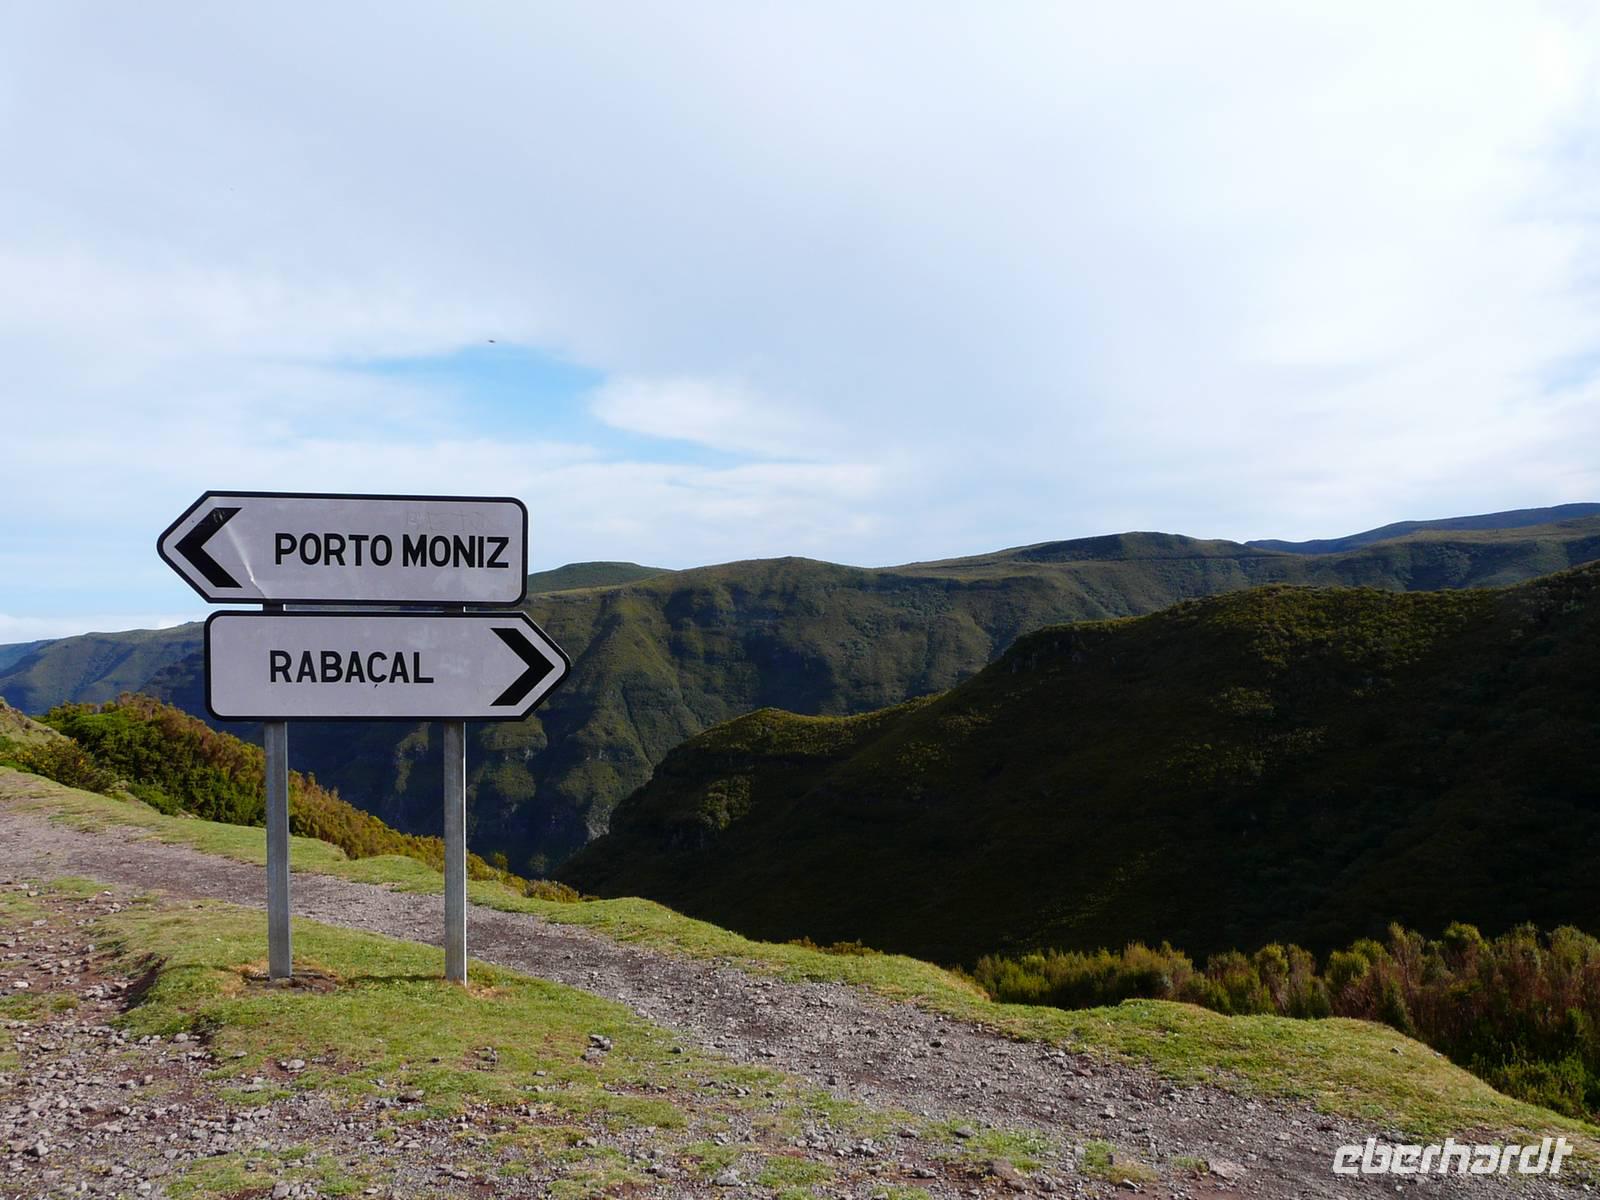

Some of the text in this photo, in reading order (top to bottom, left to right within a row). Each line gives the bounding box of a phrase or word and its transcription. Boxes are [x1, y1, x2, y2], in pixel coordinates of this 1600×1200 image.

[275, 533, 510, 569] PORTO MONIZ
[270, 650, 435, 688] RABAÇAL
